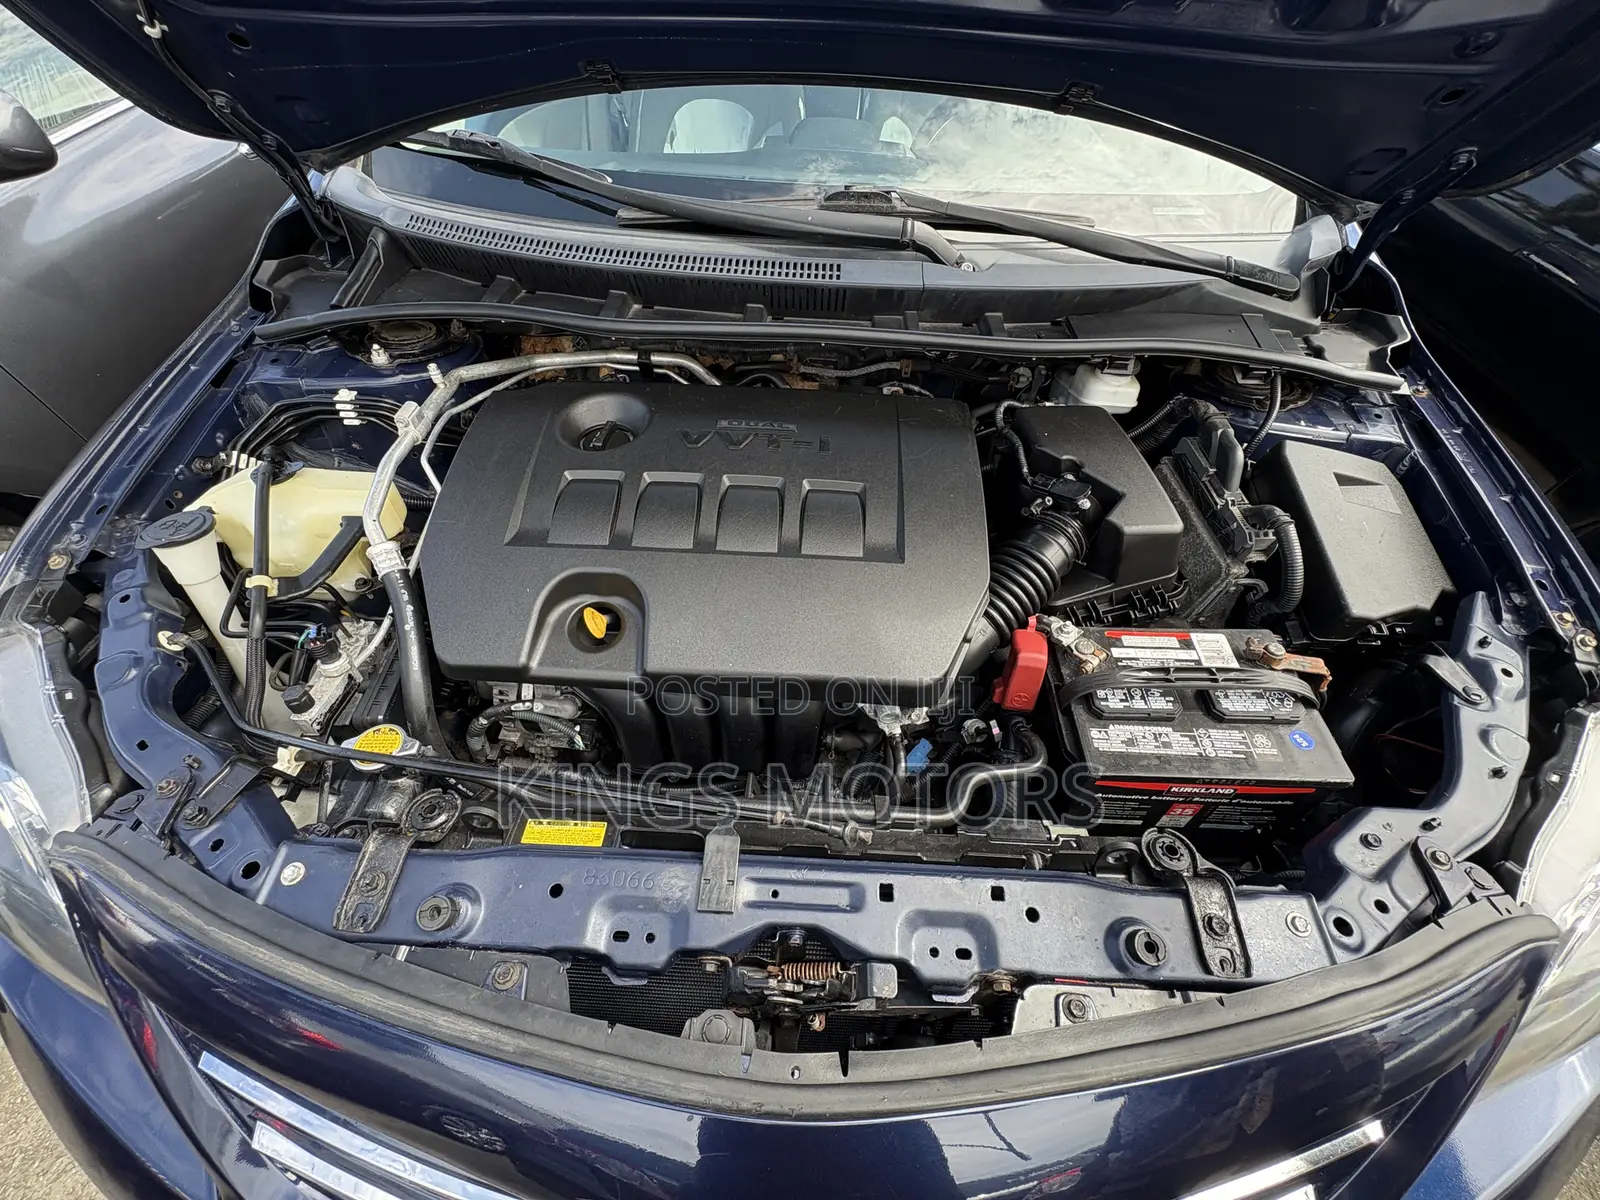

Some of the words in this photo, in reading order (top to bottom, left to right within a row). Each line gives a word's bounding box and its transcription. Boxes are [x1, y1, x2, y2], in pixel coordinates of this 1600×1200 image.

[726, 419, 791, 430] DUAL
[1170, 786, 1235, 794] KIRKLAND
[1169, 808, 1195, 816] 35
